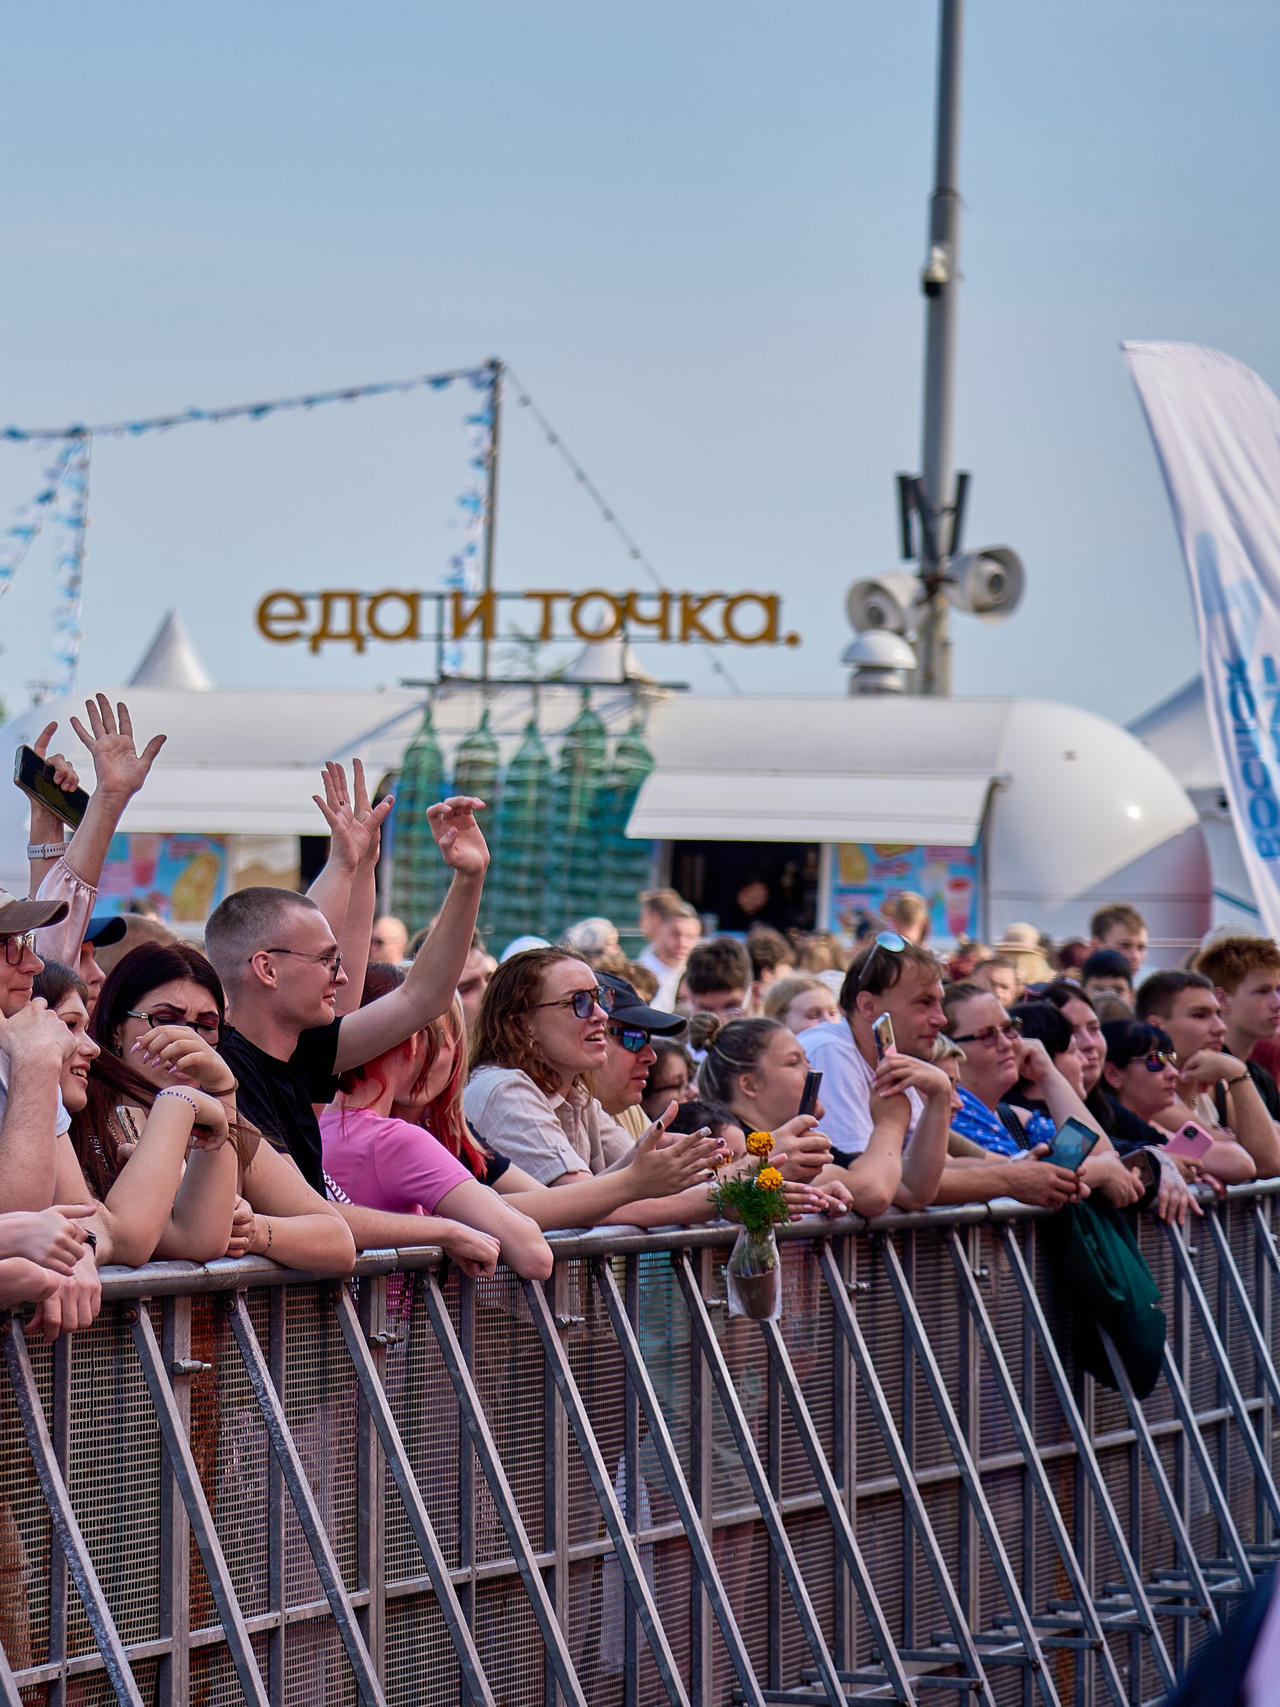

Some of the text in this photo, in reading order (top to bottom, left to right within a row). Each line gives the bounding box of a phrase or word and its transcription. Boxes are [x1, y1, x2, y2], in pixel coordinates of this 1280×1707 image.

[256, 588, 803, 656] еда и точка.
